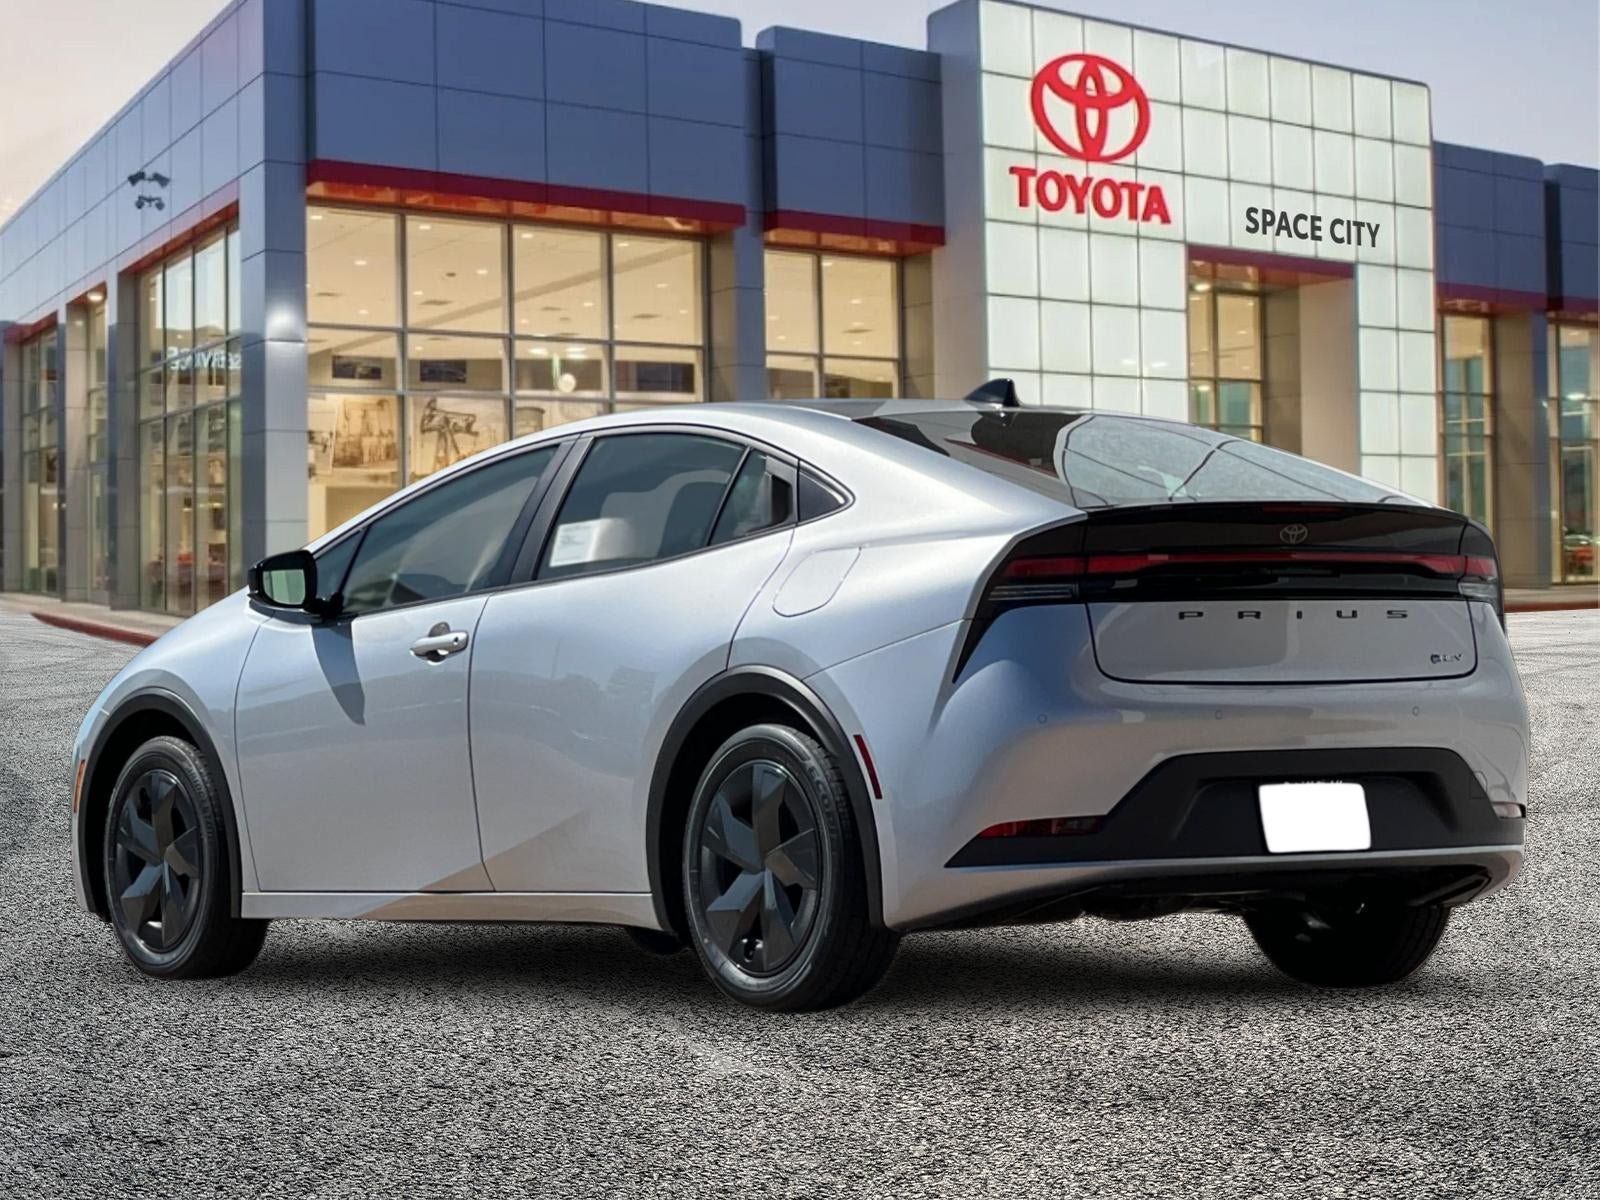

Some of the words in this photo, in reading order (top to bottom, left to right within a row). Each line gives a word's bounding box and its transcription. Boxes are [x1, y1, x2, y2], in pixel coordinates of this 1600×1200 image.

[1009, 166, 1171, 224] TOYOTA
[1245, 206, 1323, 242] SPACE
[1329, 217, 1381, 248] CITY
[1178, 609, 1409, 620] PRIUS
